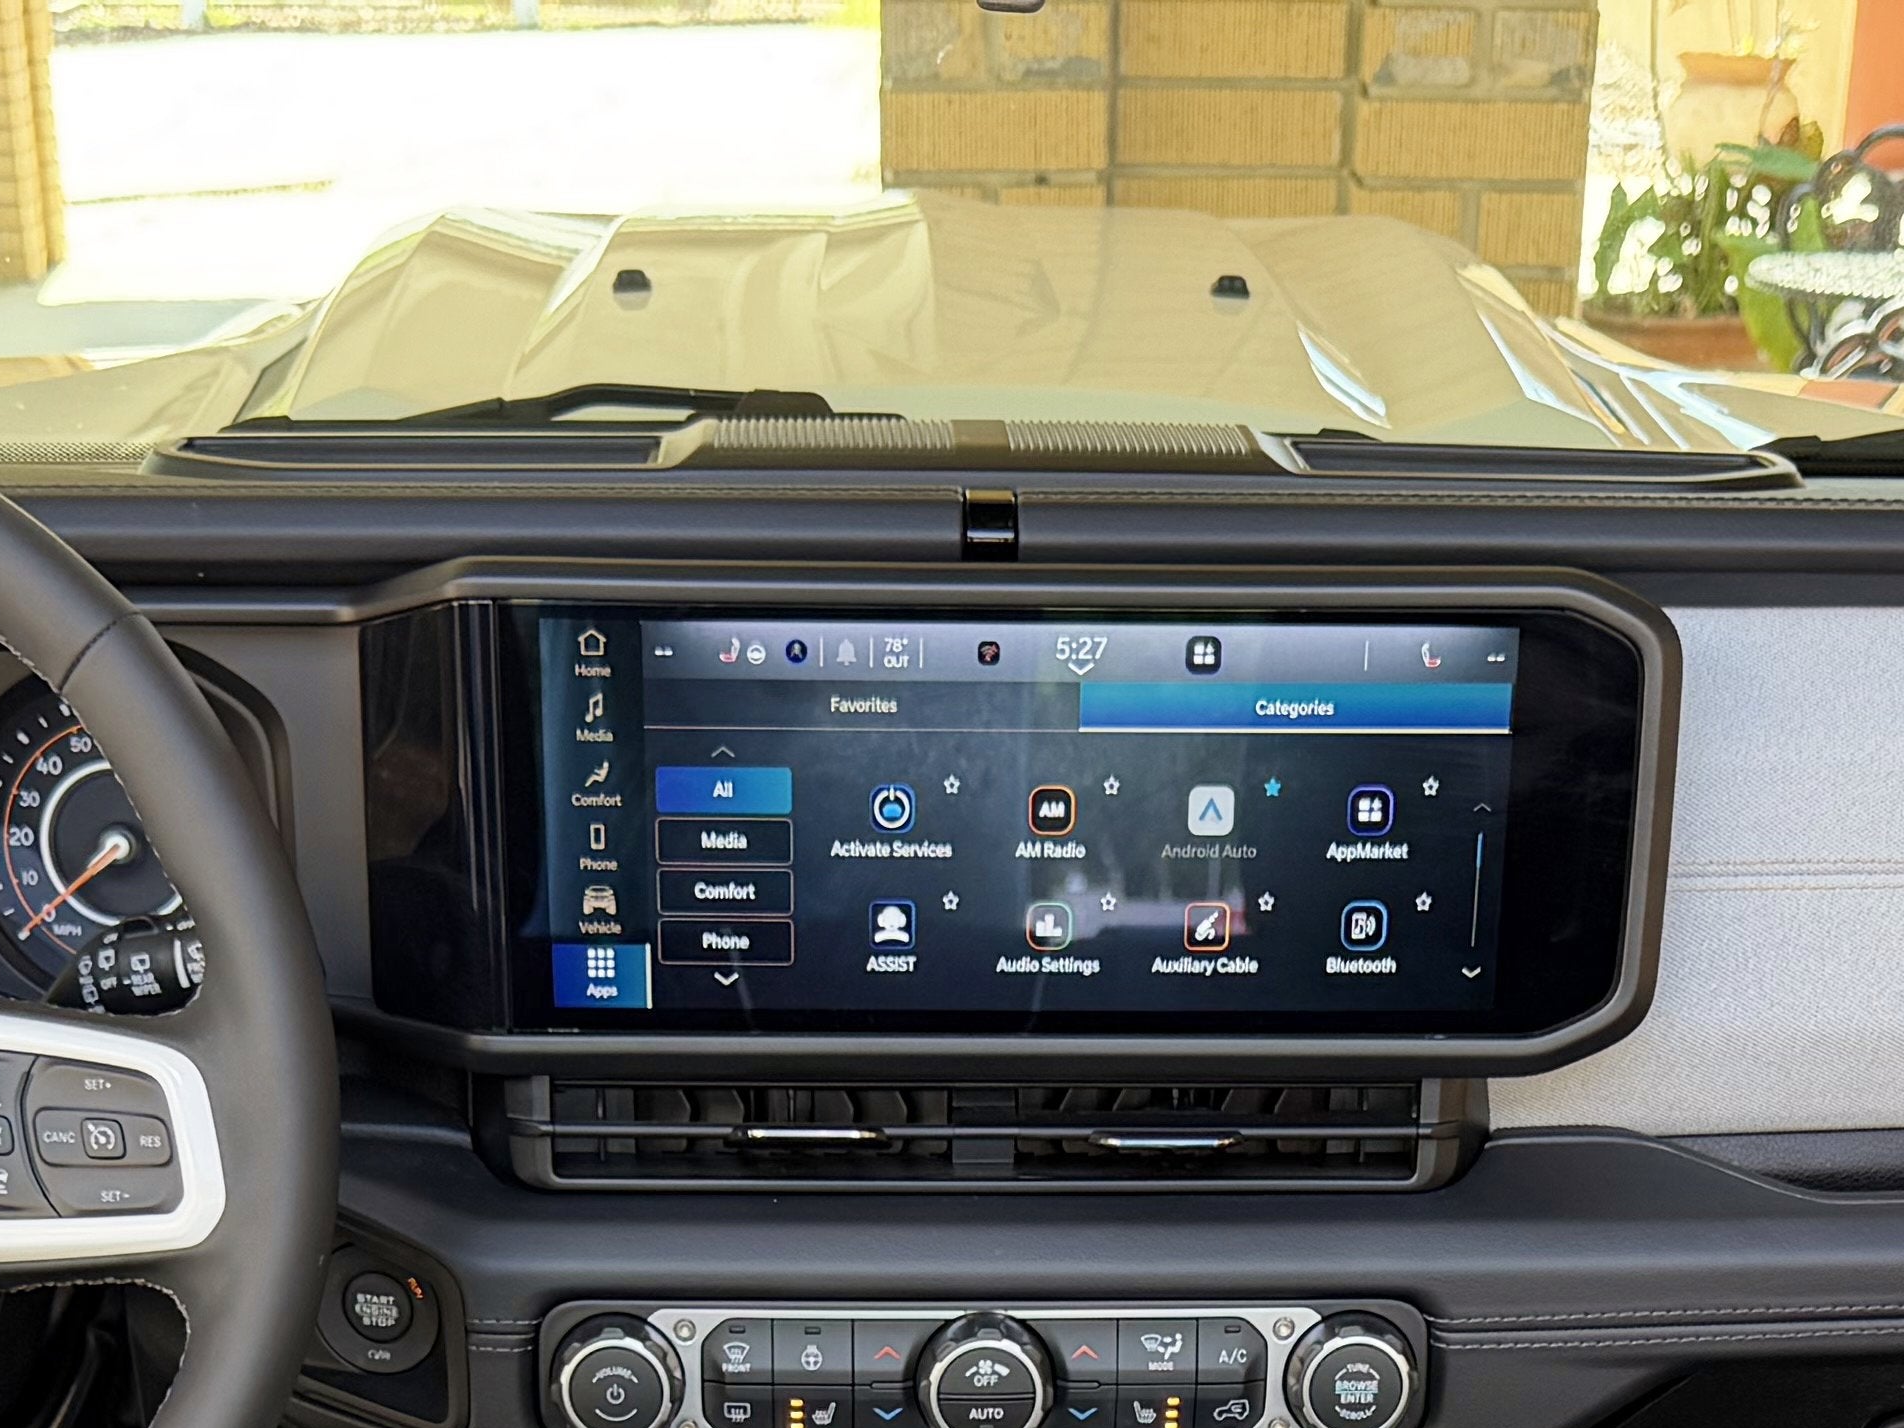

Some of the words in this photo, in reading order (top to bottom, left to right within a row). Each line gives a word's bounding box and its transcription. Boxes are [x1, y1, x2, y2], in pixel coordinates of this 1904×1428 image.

[1055, 635, 1108, 661] 5:27
[884, 655, 909, 669] OUT
[575, 664, 612, 678] Home
[831, 697, 898, 714] Favorites
[1255, 699, 1335, 718] Categories
[576, 729, 614, 743] Media
[69, 737, 93, 753] 50
[35, 755, 63, 776] 40
[713, 781, 734, 798] All
[19, 791, 41, 808] 30
[572, 793, 622, 808] Comfort
[1039, 801, 1066, 819] AM
[8, 827, 35, 847] 20
[701, 832, 748, 851] Media
[831, 840, 890, 858] Activate
[892, 841, 952, 858] Services
[1015, 843, 1043, 858] AM
[1044, 843, 1086, 859] Radio
[1161, 843, 1219, 859] Android
[1222, 843, 1257, 859] Auto
[1326, 843, 1409, 862] AppMarket
[579, 858, 618, 871] Phone
[22, 870, 39, 886] 10
[694, 881, 756, 900] Comfort
[53, 923, 82, 937] MPH
[579, 921, 622, 935] Vehicle
[702, 933, 750, 951] Phone
[866, 955, 917, 973] ASSIST
[996, 957, 1039, 974] Audio
[1041, 957, 1101, 977] Settings
[1151, 957, 1214, 976] Auxiliary
[1216, 957, 1259, 974] Cable
[1325, 957, 1397, 975] Bluetooth
[586, 984, 618, 998] Apps
[44, 1131, 76, 1143] CANC
[139, 1136, 162, 1148] RES
[1219, 1348, 1247, 1364] A/C
[973, 1375, 1000, 1387] OFF
[1335, 1380, 1378, 1391] BROWSE
[969, 1407, 1004, 1420] AUTO
